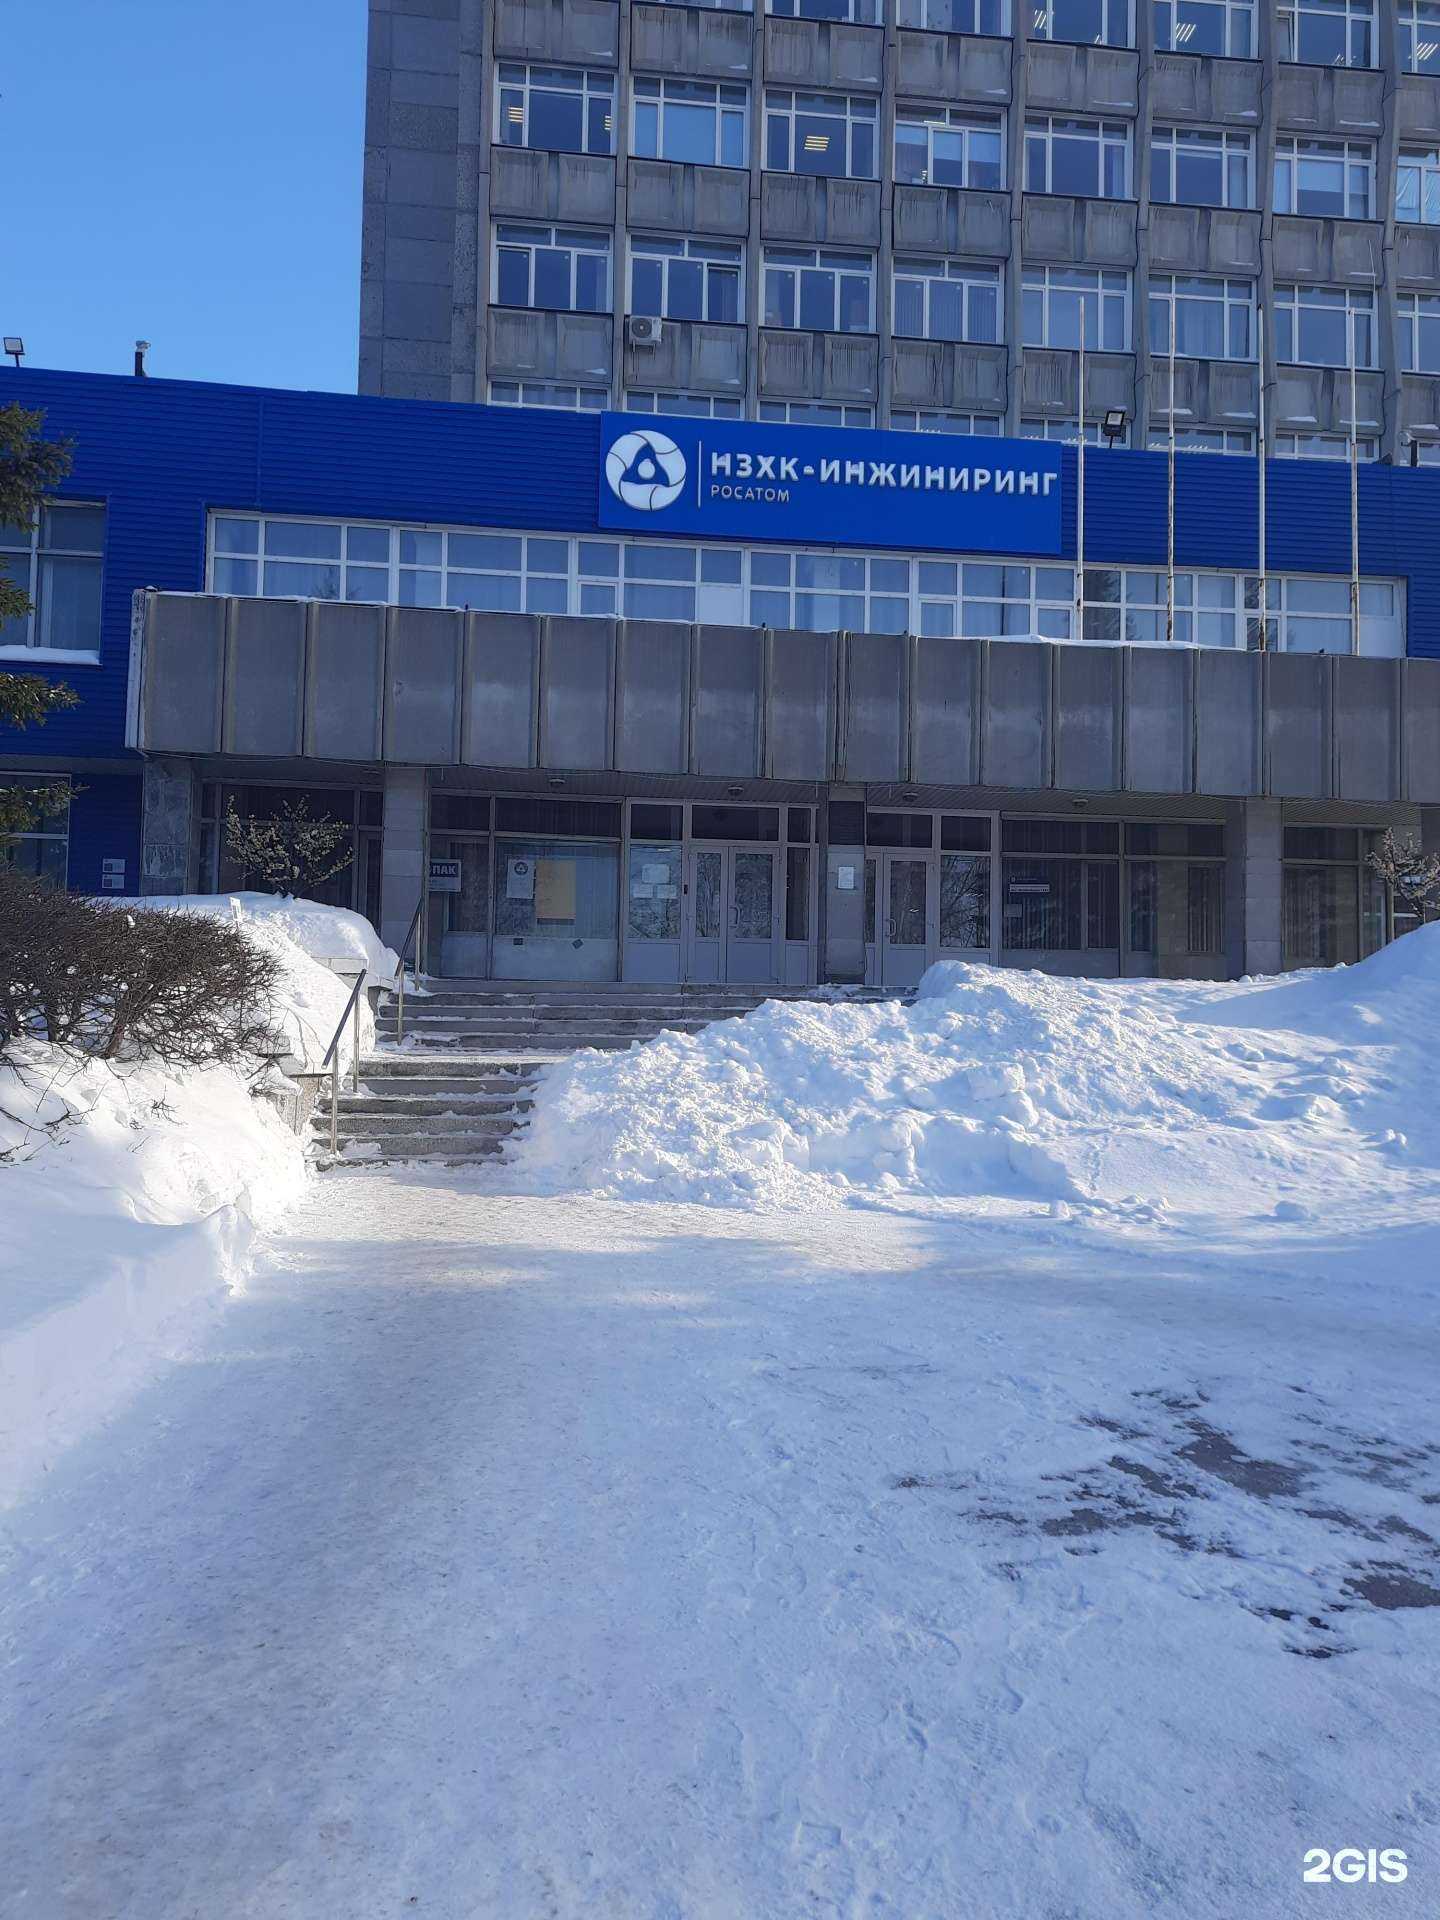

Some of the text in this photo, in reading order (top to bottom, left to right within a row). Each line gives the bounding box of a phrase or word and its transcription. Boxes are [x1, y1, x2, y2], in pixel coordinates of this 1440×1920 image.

[711, 451, 1058, 496] НЗХК-ИНЖИНИРИНГ
[711, 484, 790, 502] РОСАТОМ
[429, 865, 457, 875] ПАК
